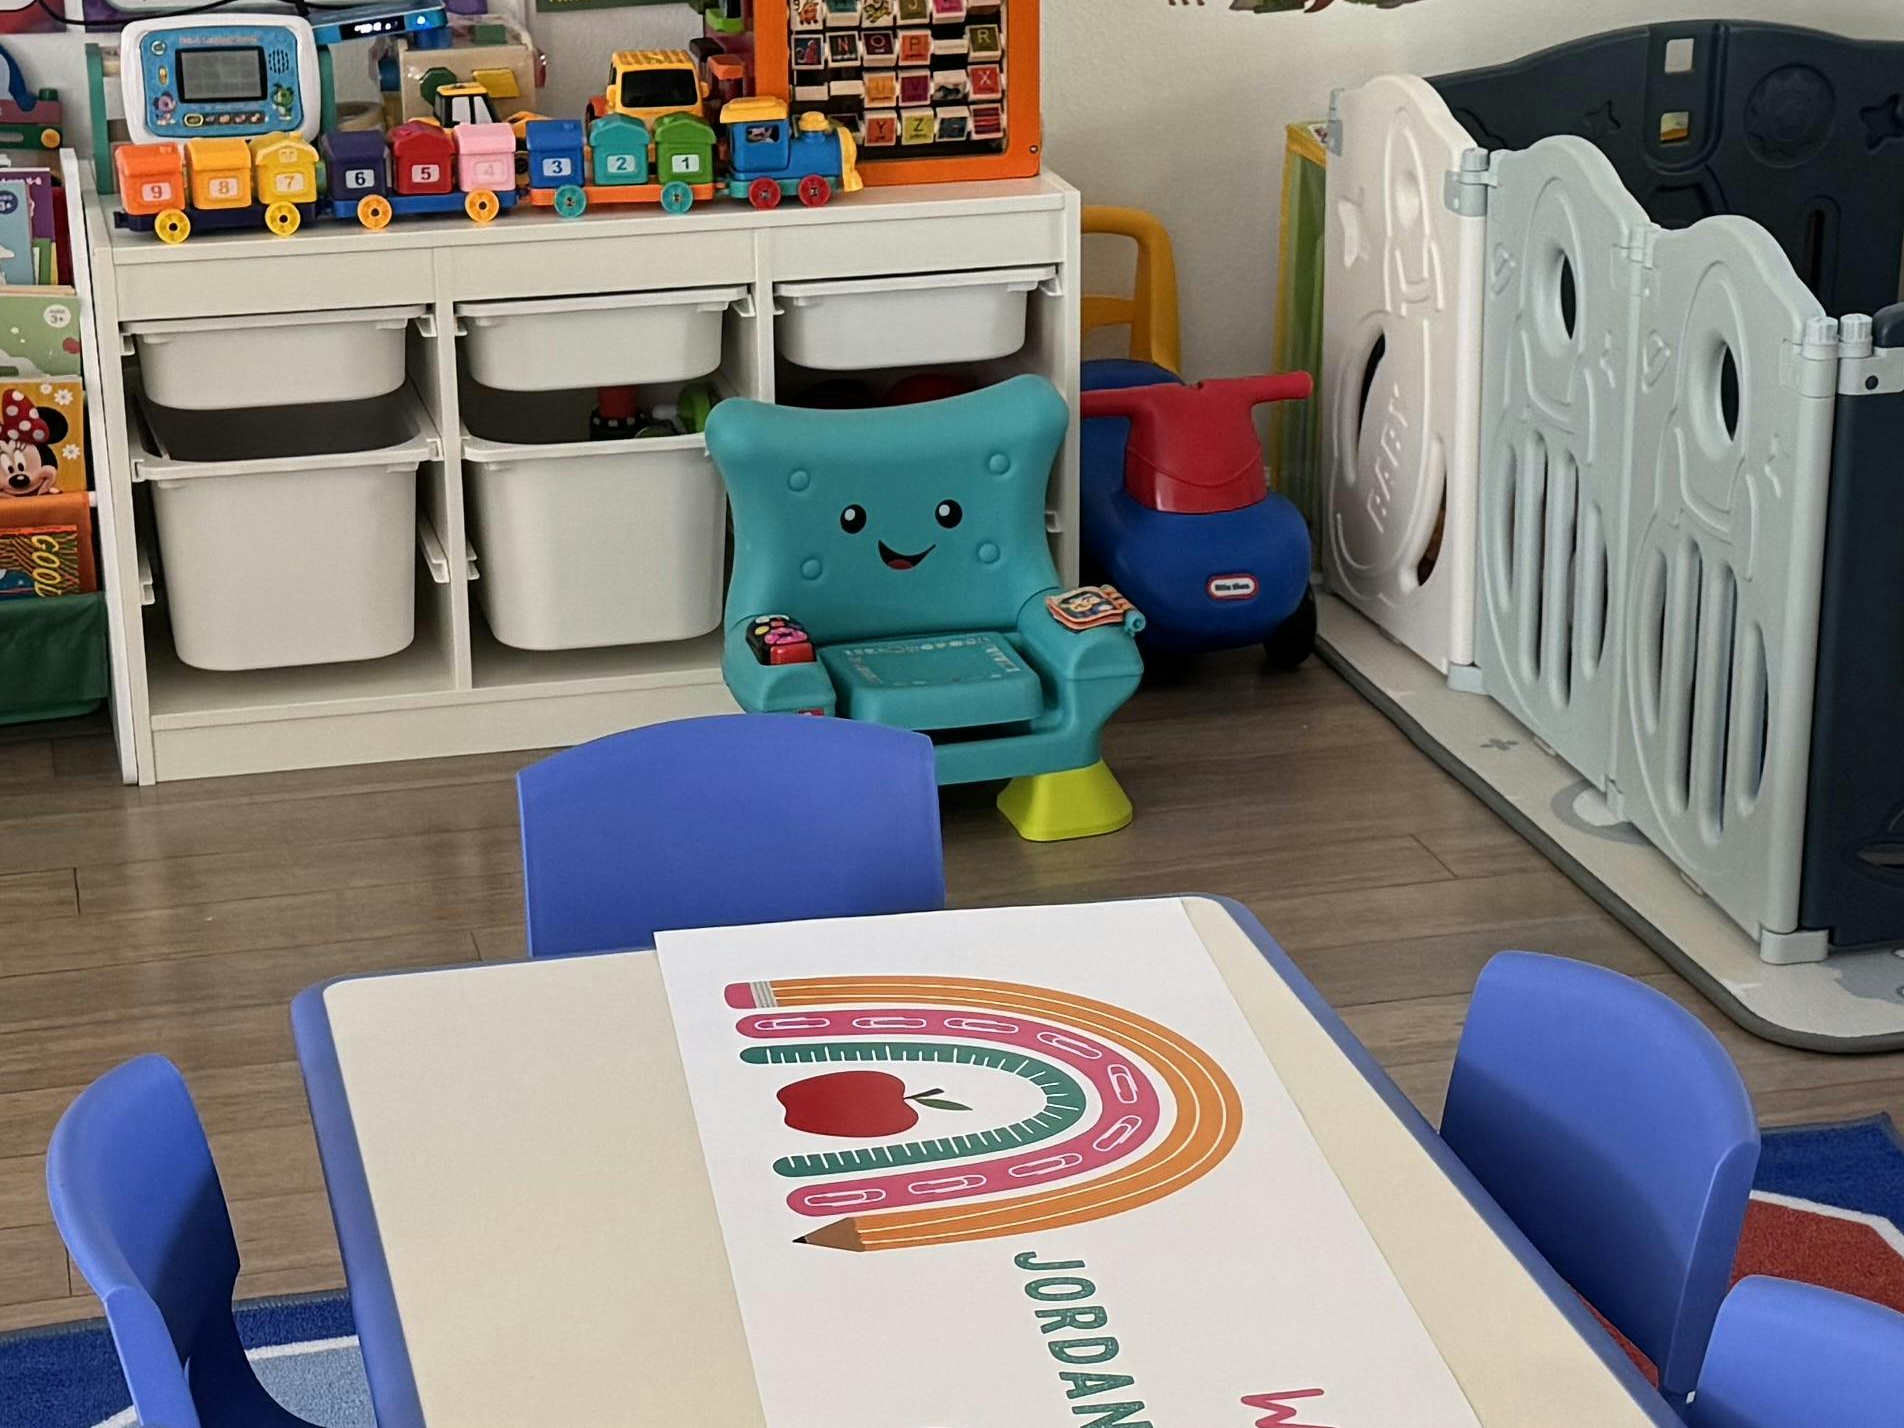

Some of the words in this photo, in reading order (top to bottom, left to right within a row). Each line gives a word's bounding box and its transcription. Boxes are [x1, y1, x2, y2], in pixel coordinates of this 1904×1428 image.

[552, 161, 563, 174] 3
[616, 158, 627, 170] 2
[682, 157, 690, 170] 1
[355, 172, 365, 185] 6
[421, 167, 431, 180] 5
[218, 182, 229, 194] 8
[284, 176, 295, 190] 7
[150, 186, 163, 199] 9
